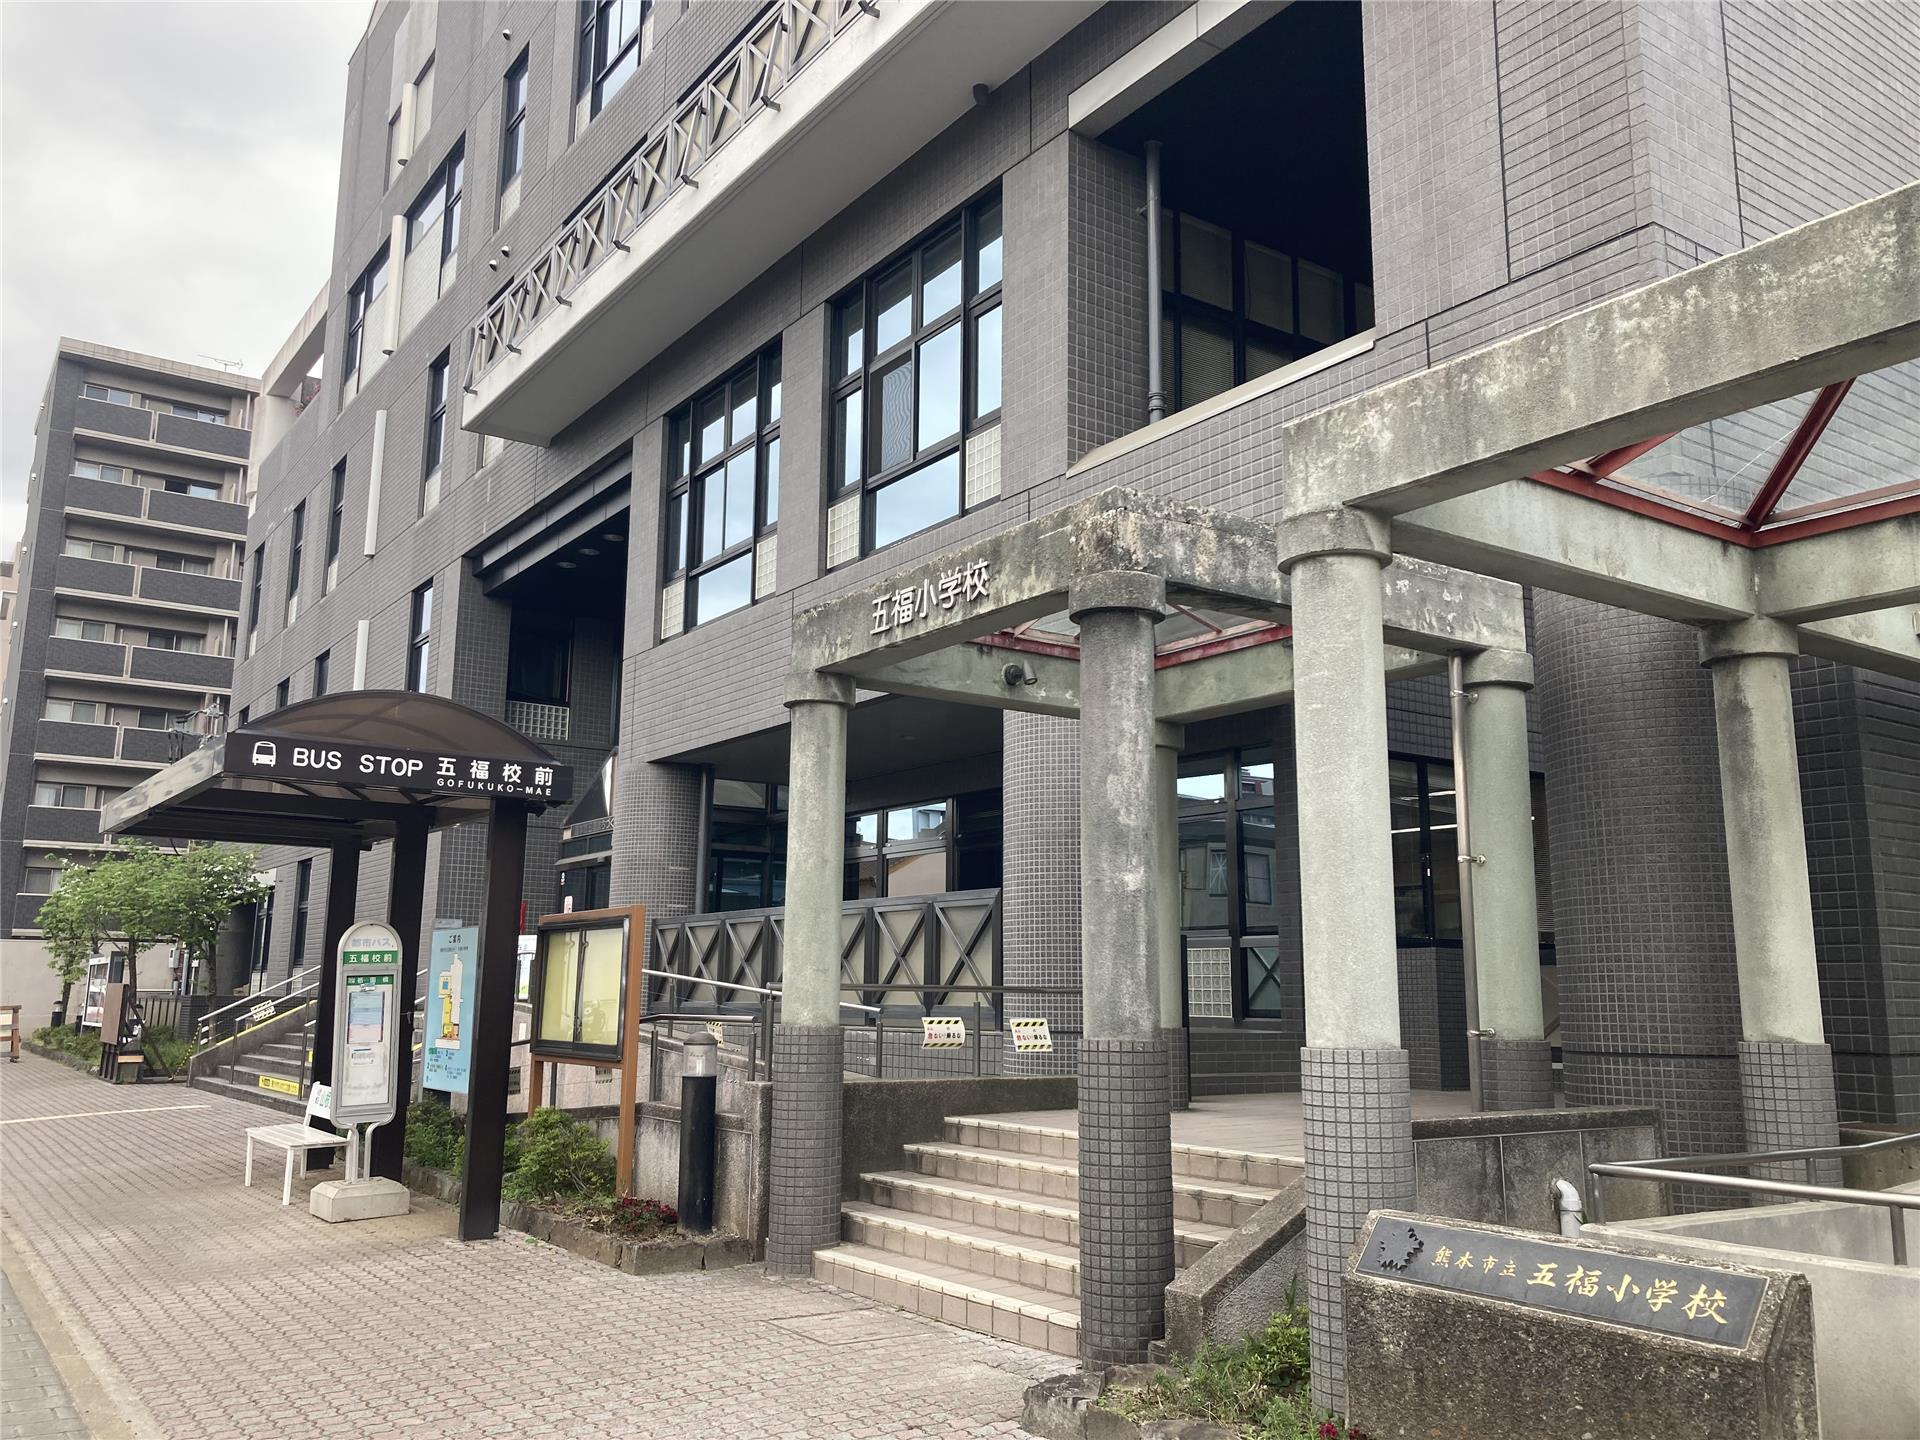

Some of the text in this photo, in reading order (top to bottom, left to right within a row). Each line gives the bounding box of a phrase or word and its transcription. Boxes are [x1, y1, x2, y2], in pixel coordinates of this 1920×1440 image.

[870, 558, 991, 635] 五福小学校
[292, 747, 554, 786] BUS STOP 五福校前
[436, 778, 552, 796] GOFUKUKO-MAE
[348, 953, 392, 963] 五福校前
[1431, 1245, 1729, 1324] 熊本市立 五福小学校
